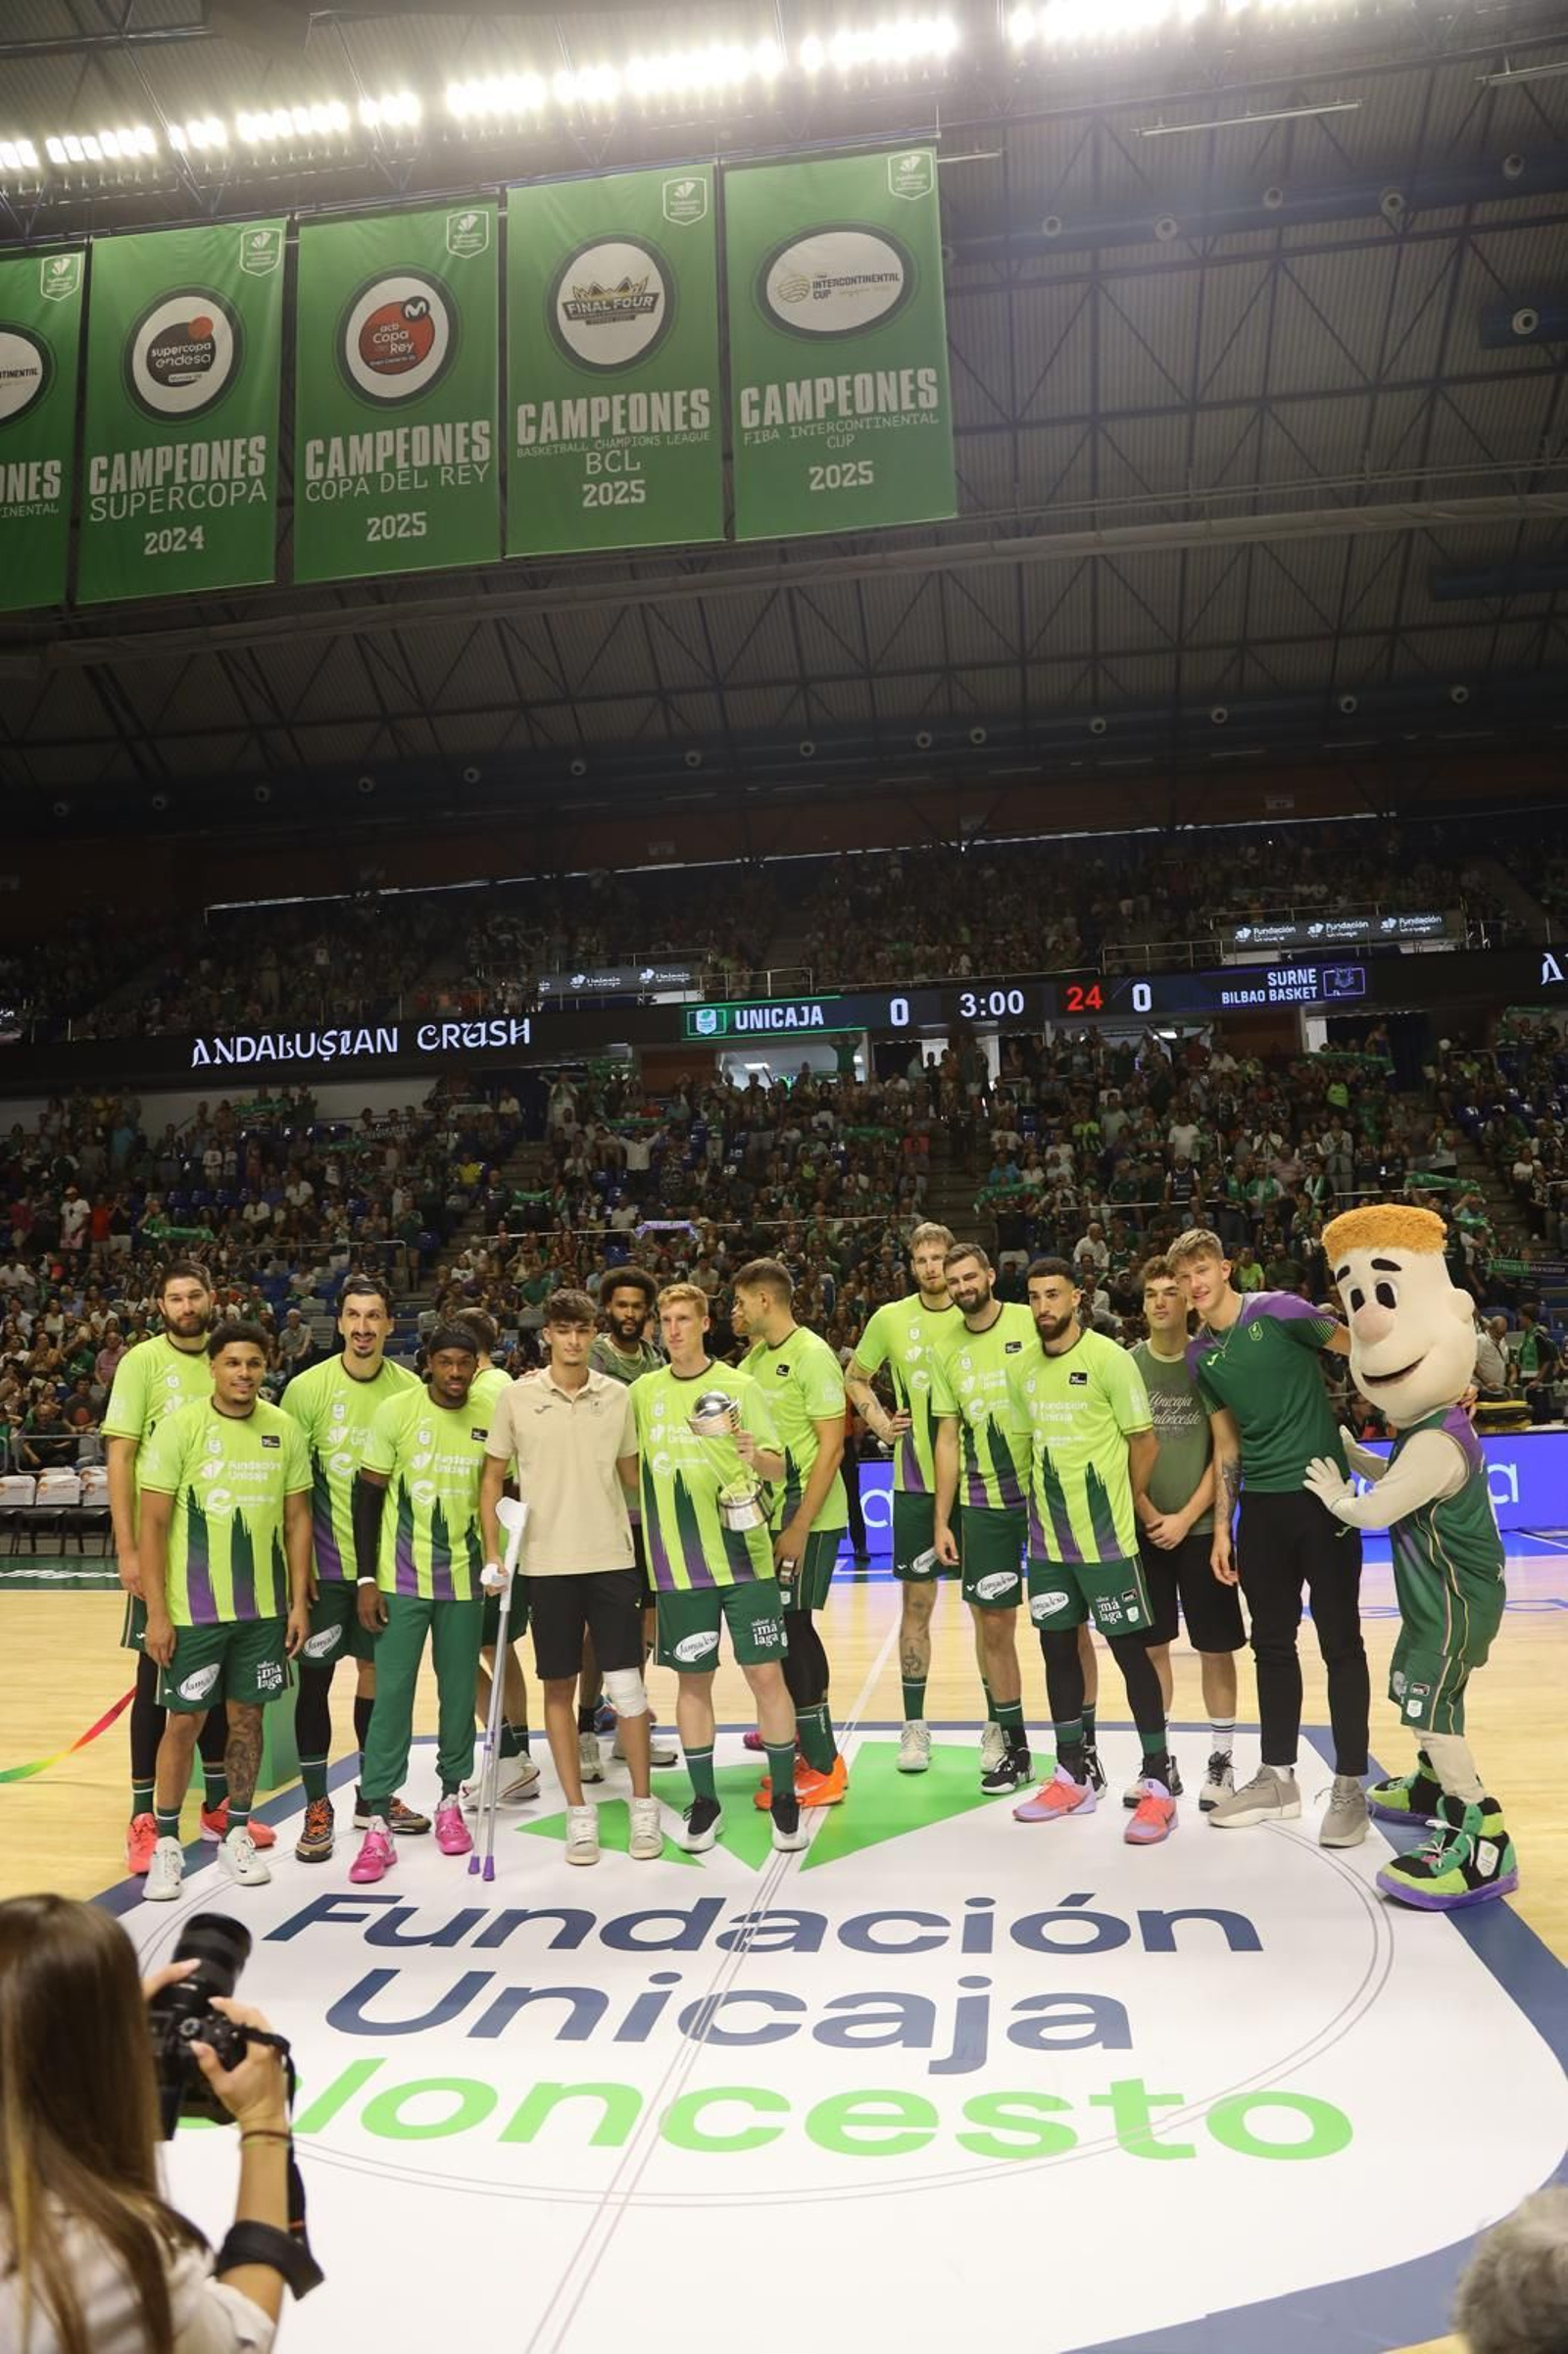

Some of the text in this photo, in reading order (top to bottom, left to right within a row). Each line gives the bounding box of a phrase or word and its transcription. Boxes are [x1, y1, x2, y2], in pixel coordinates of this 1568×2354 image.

[566, 299, 612, 315] FINAL
[613, 296, 654, 309] FOUR
[151, 342, 212, 358] supercopa
[372, 330, 410, 345] Copa
[390, 342, 414, 354] Rey
[156, 354, 211, 368] endesa
[740, 368, 939, 428] CAMPEONES
[516, 388, 710, 445] CAMPEONES
[744, 413, 939, 446] FIBA INTERCONTINENTAL
[306, 420, 491, 480] CAMPEONES
[516, 431, 710, 458] BASKETBALL CHAMPIONS LEAGUE
[826, 434, 856, 449] CUP
[89, 435, 267, 495] CAMPEONES
[586, 450, 641, 474] BCL
[808, 461, 874, 490] 2025
[306, 463, 490, 502] COPA DEL REY
[582, 479, 646, 507] 2025
[89, 478, 268, 521] SUPERCOPA
[143, 525, 205, 555] 2024
[367, 512, 426, 542] 2025
[1267, 968, 1316, 986] SURNE
[959, 990, 1025, 1018] 3:00
[1066, 986, 1103, 1012] 24
[1132, 983, 1152, 1012] 0
[1221, 986, 1318, 1005] BILBAO BASKET
[735, 1005, 824, 1031] UNICAJA
[890, 998, 909, 1027] 0
[191, 1017, 530, 1068] ANDALUSIAN CRUSH
[1100, 1610, 1123, 1624] laga
[754, 1633, 779, 1646] laga
[257, 1674, 282, 1690] laga
[264, 1893, 1264, 1954] Fundación
[324, 1968, 1133, 2076] Unicaja
